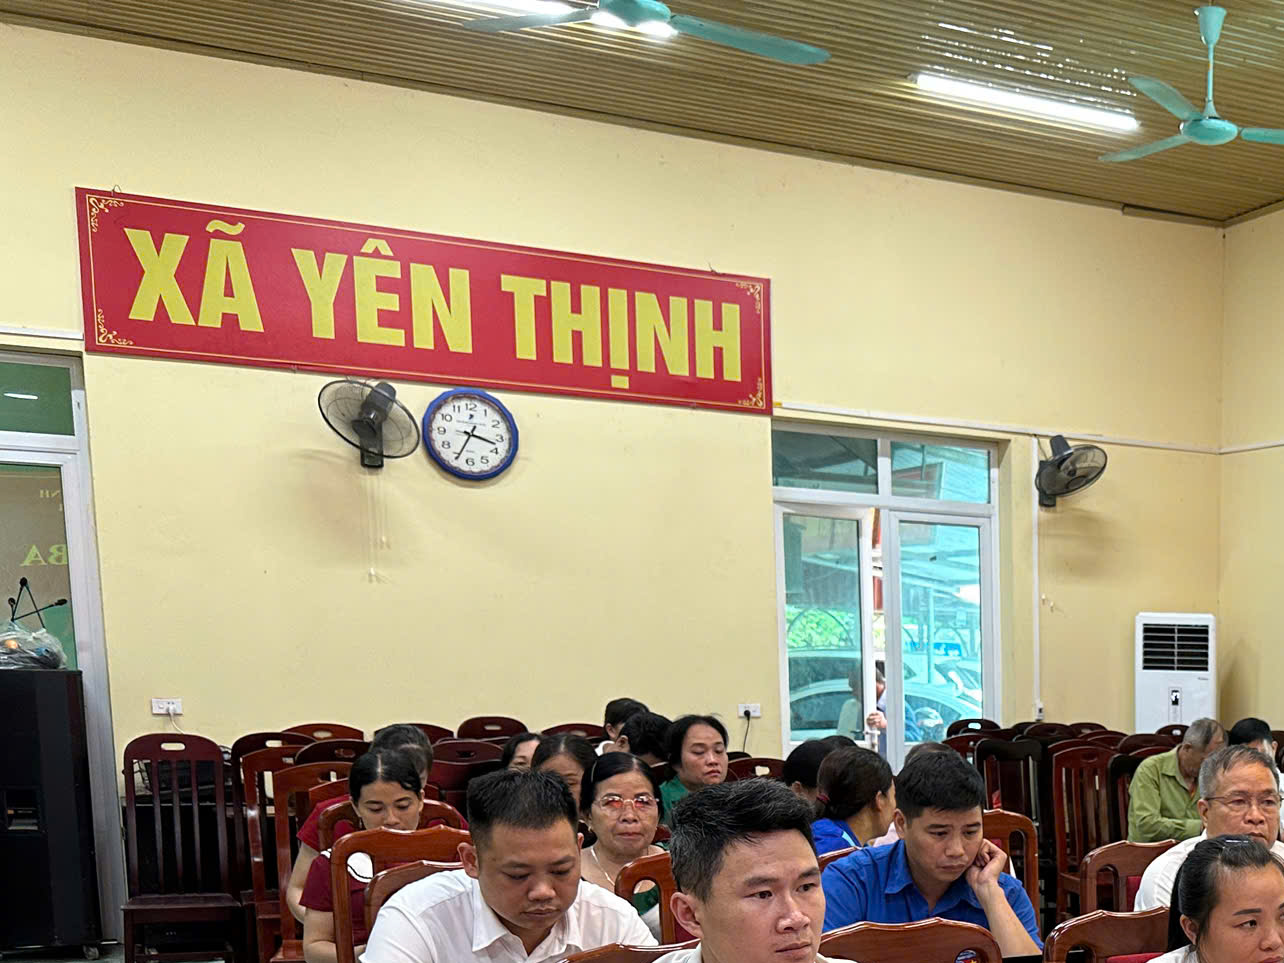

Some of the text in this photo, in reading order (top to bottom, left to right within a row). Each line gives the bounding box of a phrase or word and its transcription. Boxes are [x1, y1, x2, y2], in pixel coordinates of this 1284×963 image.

[123, 220, 742, 389] XÃ YÊN THỊNH
